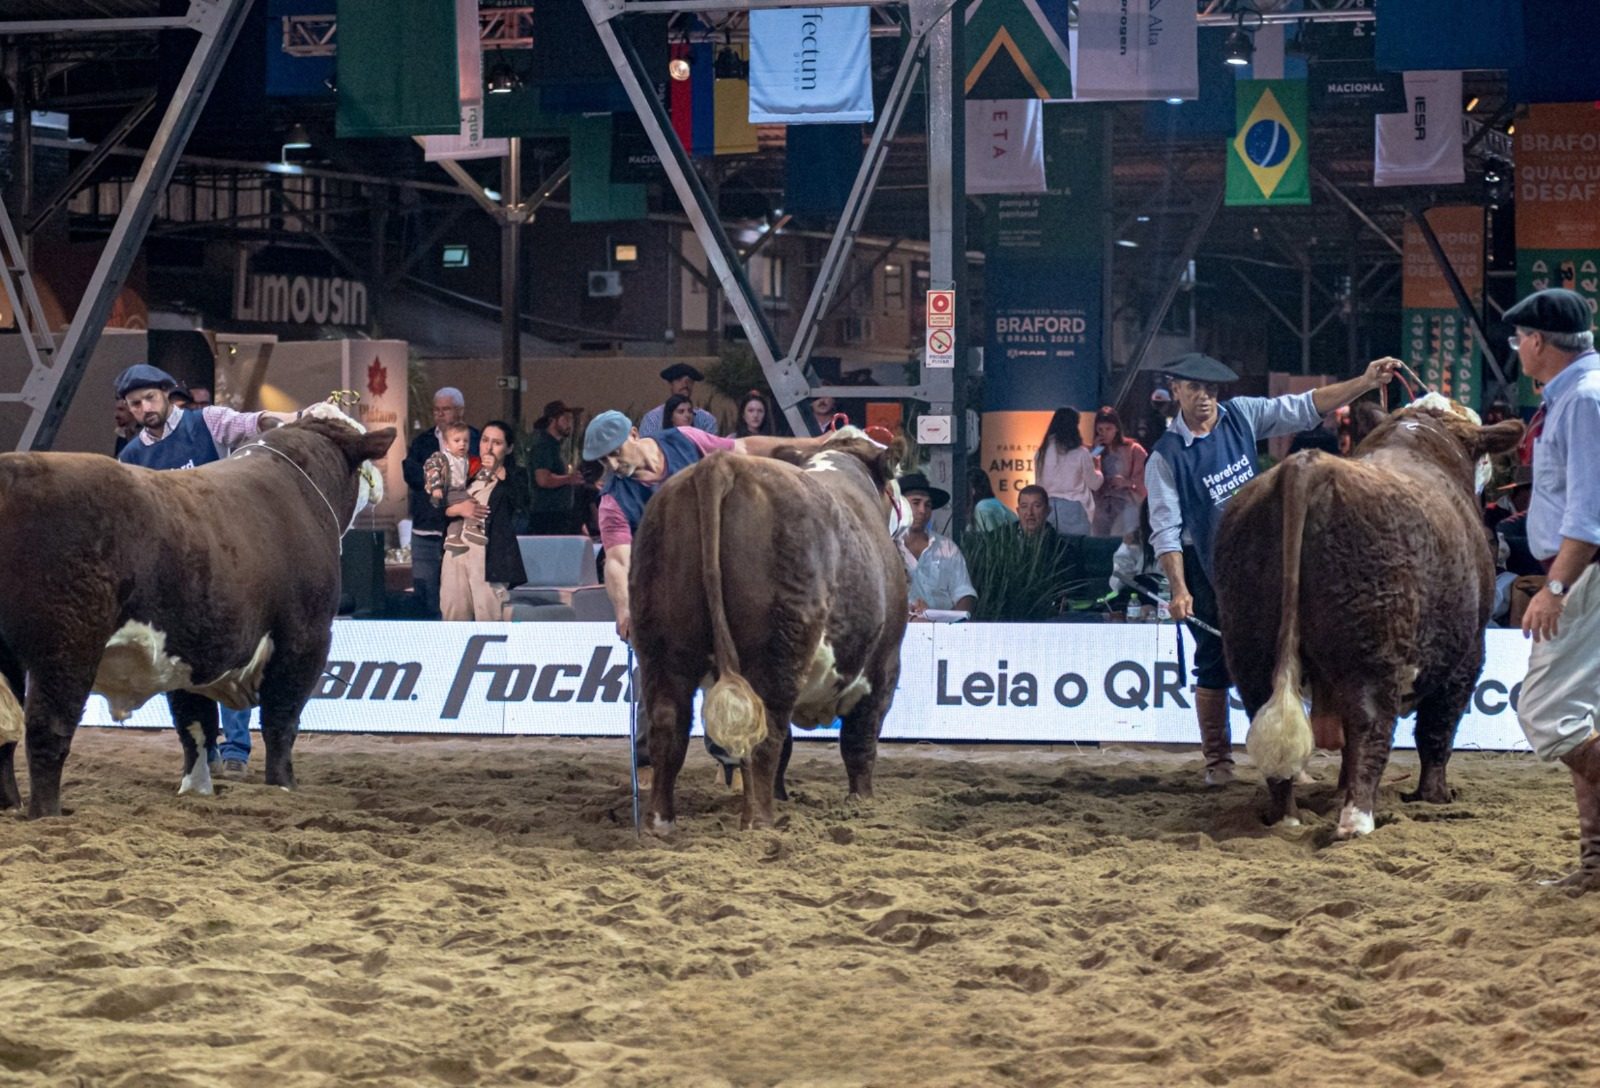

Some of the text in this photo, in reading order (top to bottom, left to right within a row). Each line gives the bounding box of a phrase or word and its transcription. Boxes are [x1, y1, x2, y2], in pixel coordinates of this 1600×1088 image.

[1148, 14, 1164, 46] Alta
[801, 7, 824, 91] fectum
[1327, 82, 1385, 93] NACIONAL
[992, 98, 1009, 159] ETA
[1414, 96, 1427, 141] IESA
[1521, 133, 1600, 151] BRAFO
[237, 248, 368, 325] Limousin
[996, 316, 1086, 333] BRAFORD
[1007, 335, 1046, 343] BRASIL
[989, 459, 1033, 472] AMBI
[1201, 453, 1251, 489] Hereford
[999, 479, 1008, 492] E
[936, 659, 1038, 708] Leia
[1054, 672, 1089, 708] o
